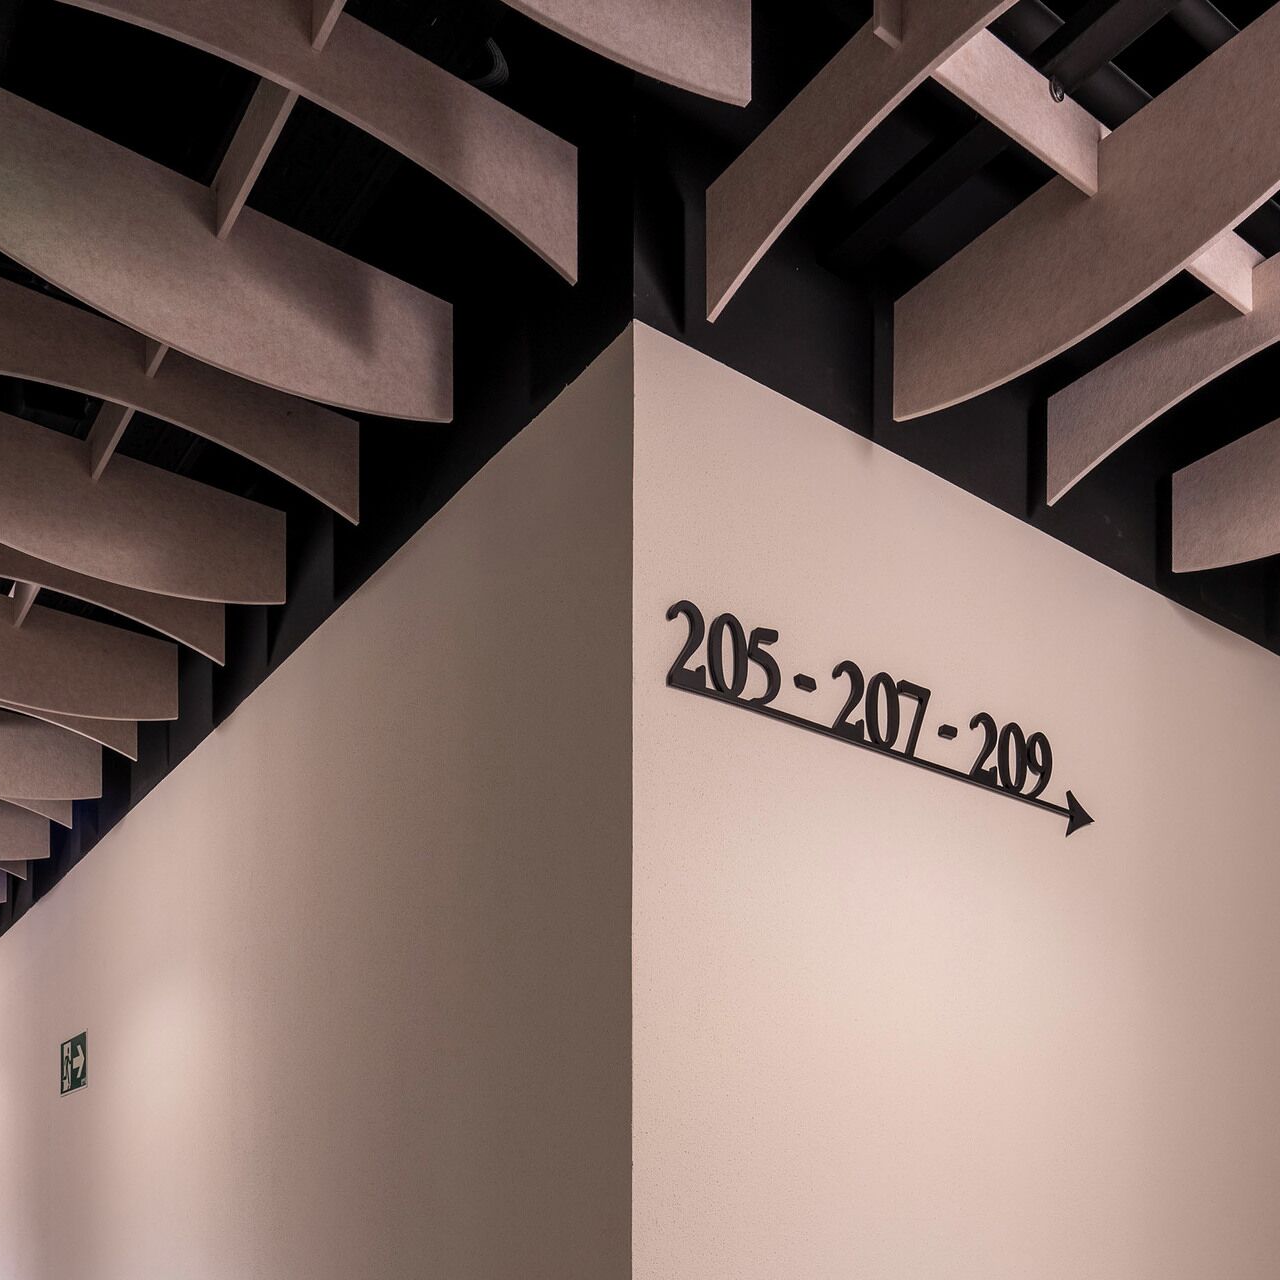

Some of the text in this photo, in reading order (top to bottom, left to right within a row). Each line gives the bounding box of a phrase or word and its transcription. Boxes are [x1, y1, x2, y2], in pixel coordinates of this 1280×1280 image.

[666, 599, 781, 706] 205
[832, 660, 931, 758] 207
[969, 712, 1053, 800] 209
